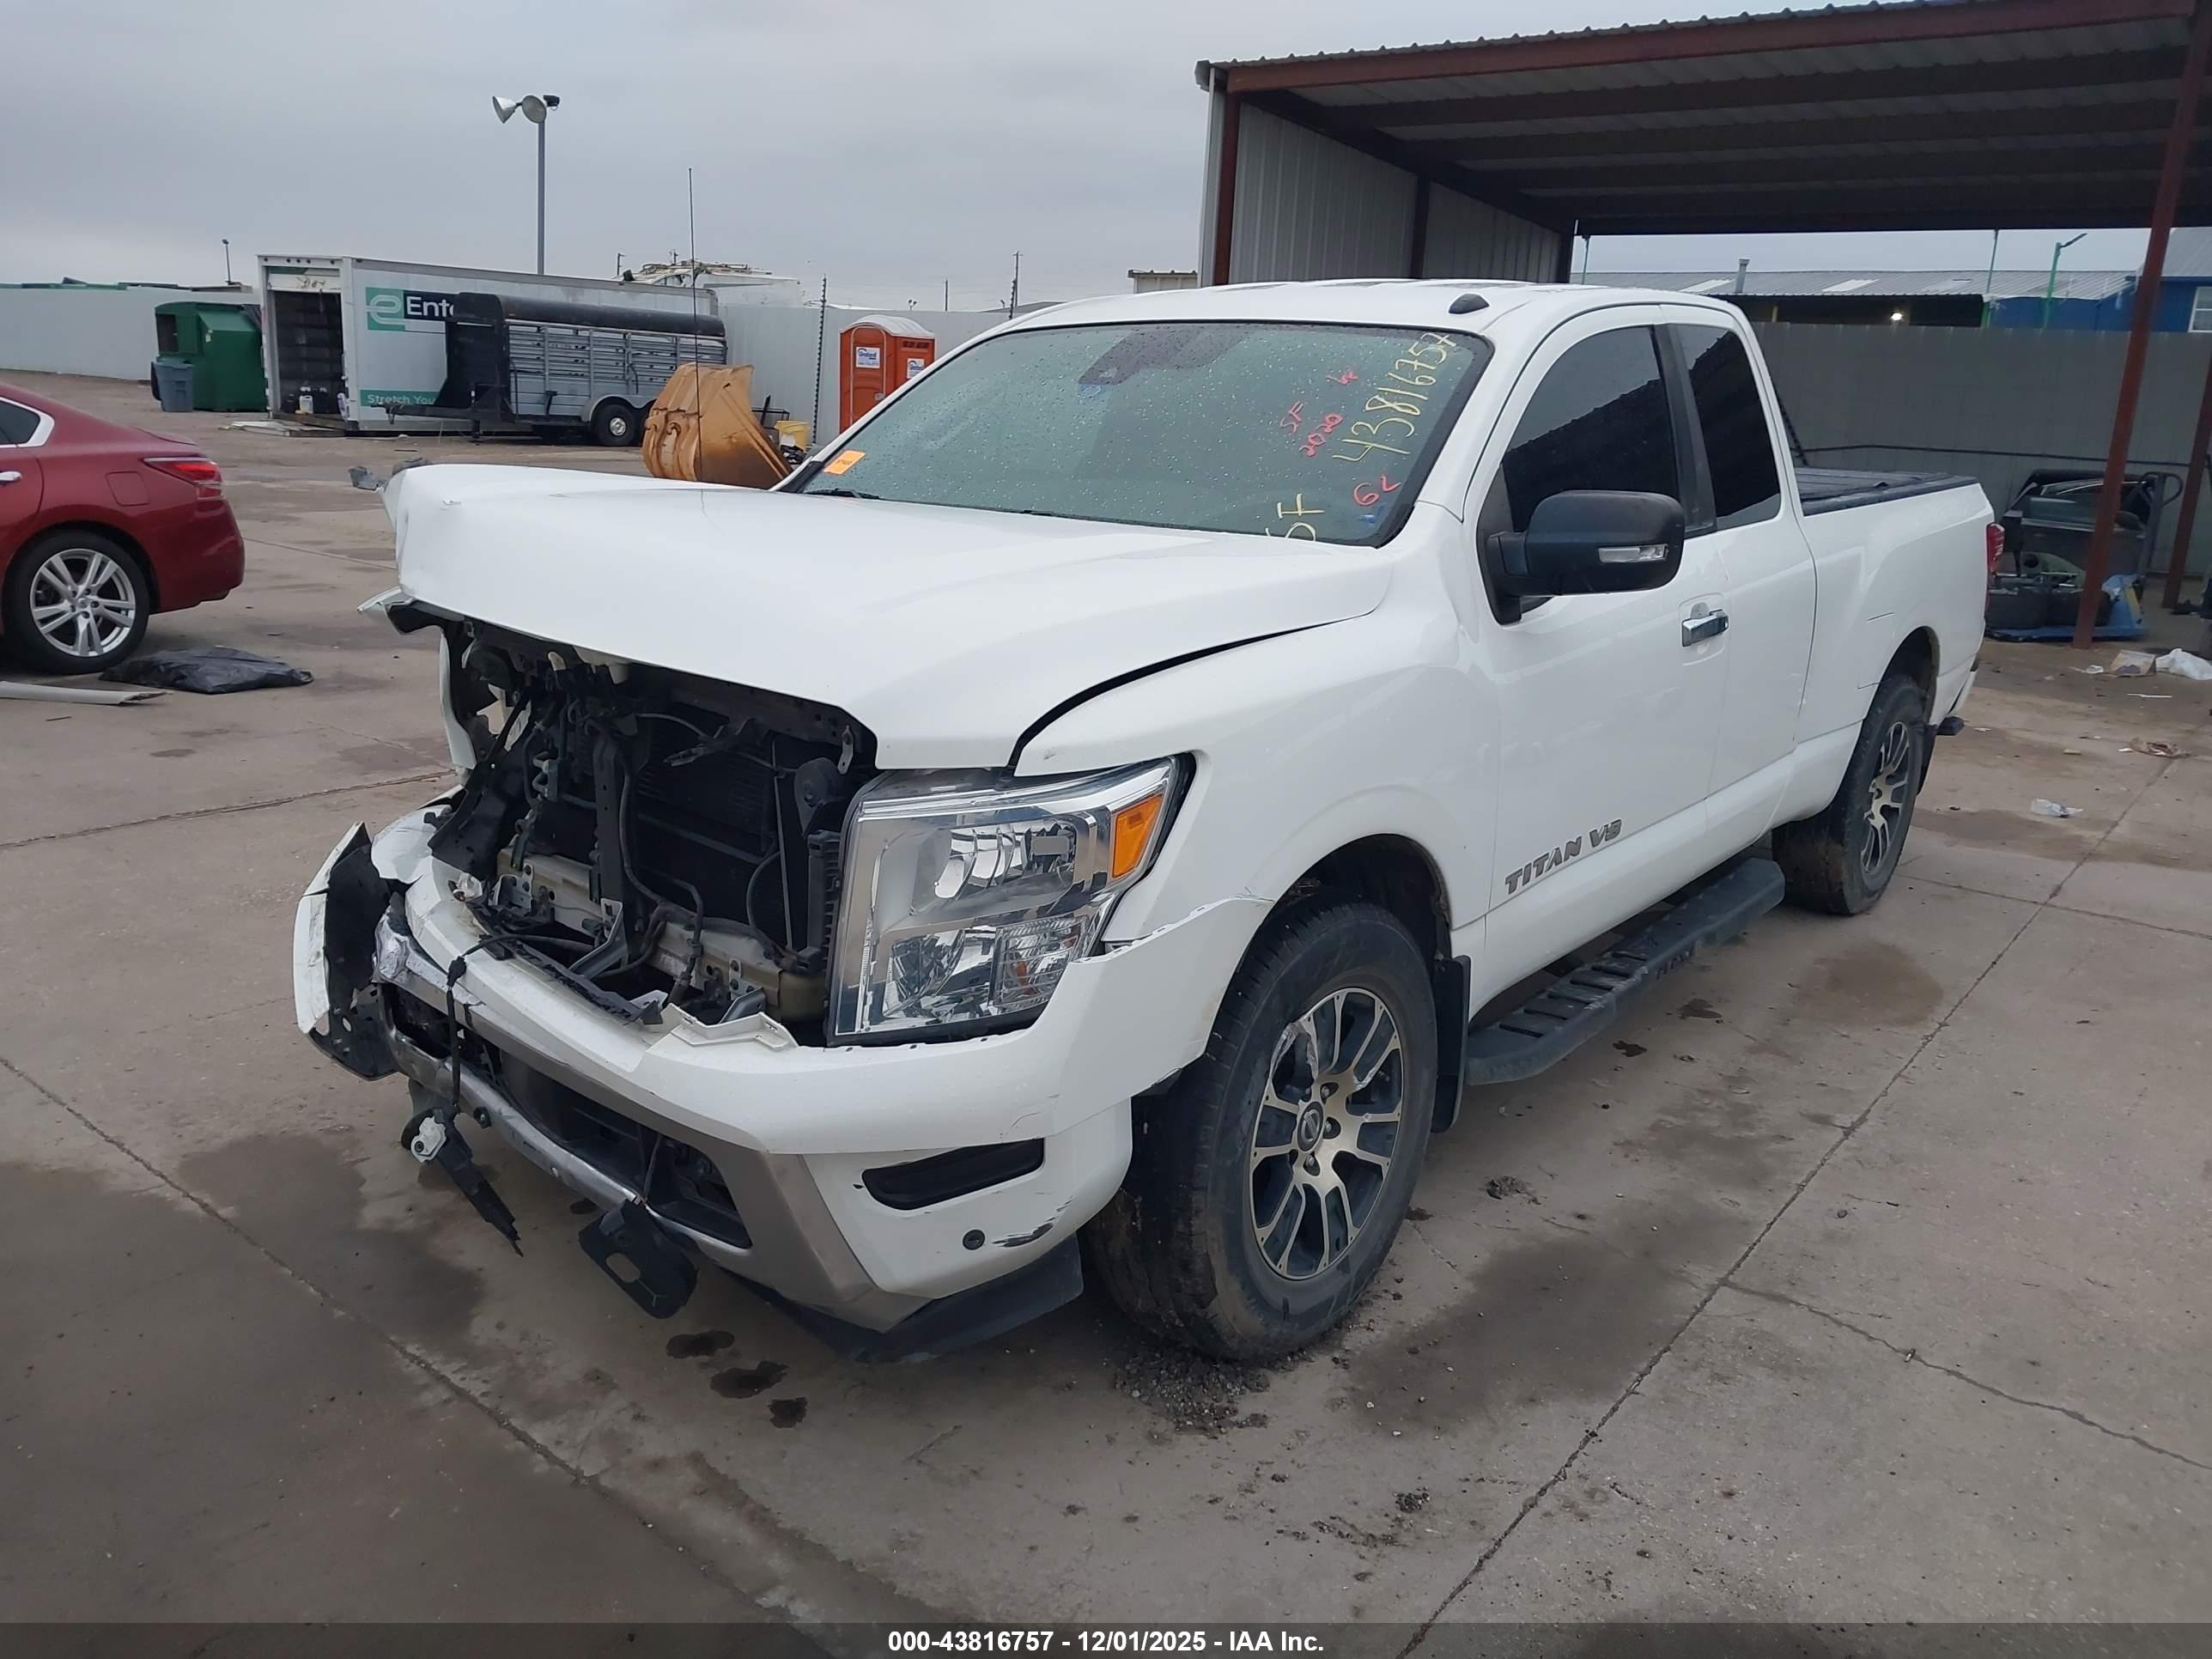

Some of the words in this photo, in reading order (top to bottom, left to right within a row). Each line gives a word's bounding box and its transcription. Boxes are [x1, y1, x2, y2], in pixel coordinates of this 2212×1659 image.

[368, 394, 410, 405] Stretch
[1332, 332, 1457, 461] 43816757
[1504, 836, 1582, 895] TITAN
